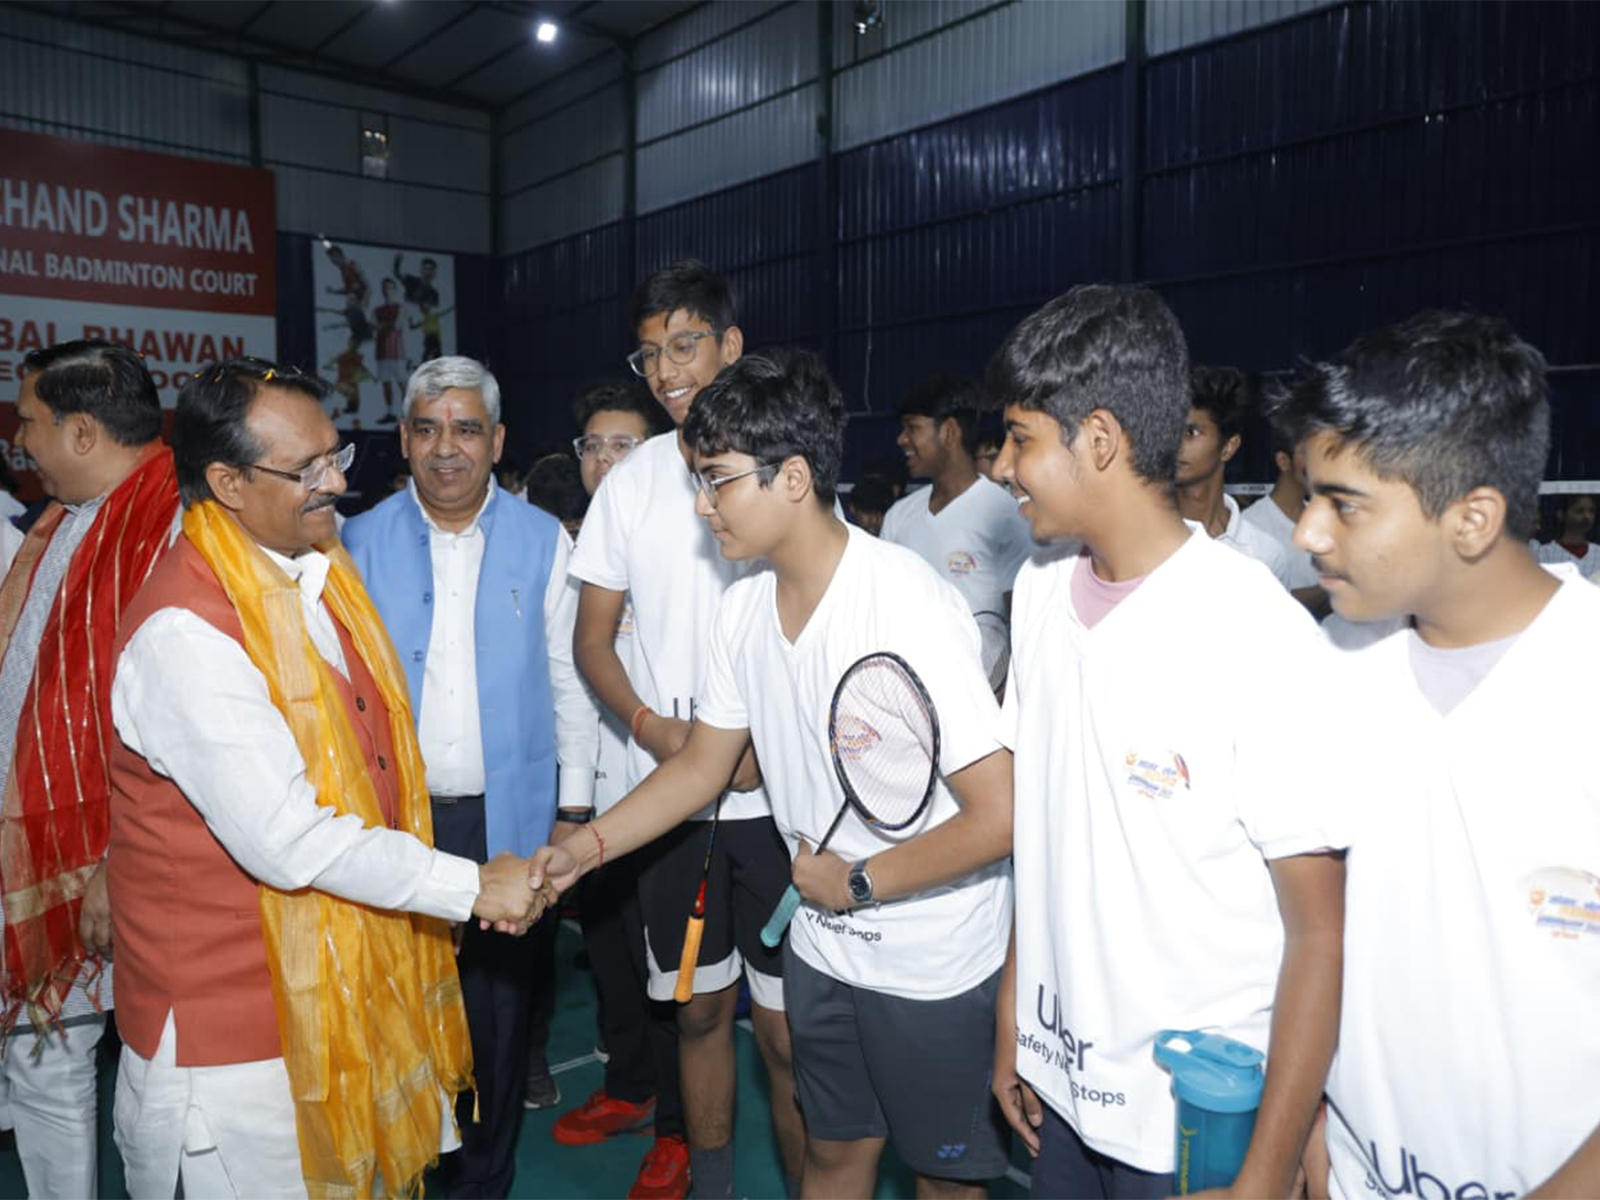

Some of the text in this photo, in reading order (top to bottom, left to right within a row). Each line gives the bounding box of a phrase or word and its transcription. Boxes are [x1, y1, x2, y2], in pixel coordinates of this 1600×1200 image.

[0, 178, 255, 254] HAND SHARMA
[45, 252, 184, 291] BADMINTON
[189, 268, 258, 296] COURT
[1370, 1140, 1517, 1200] Ube
